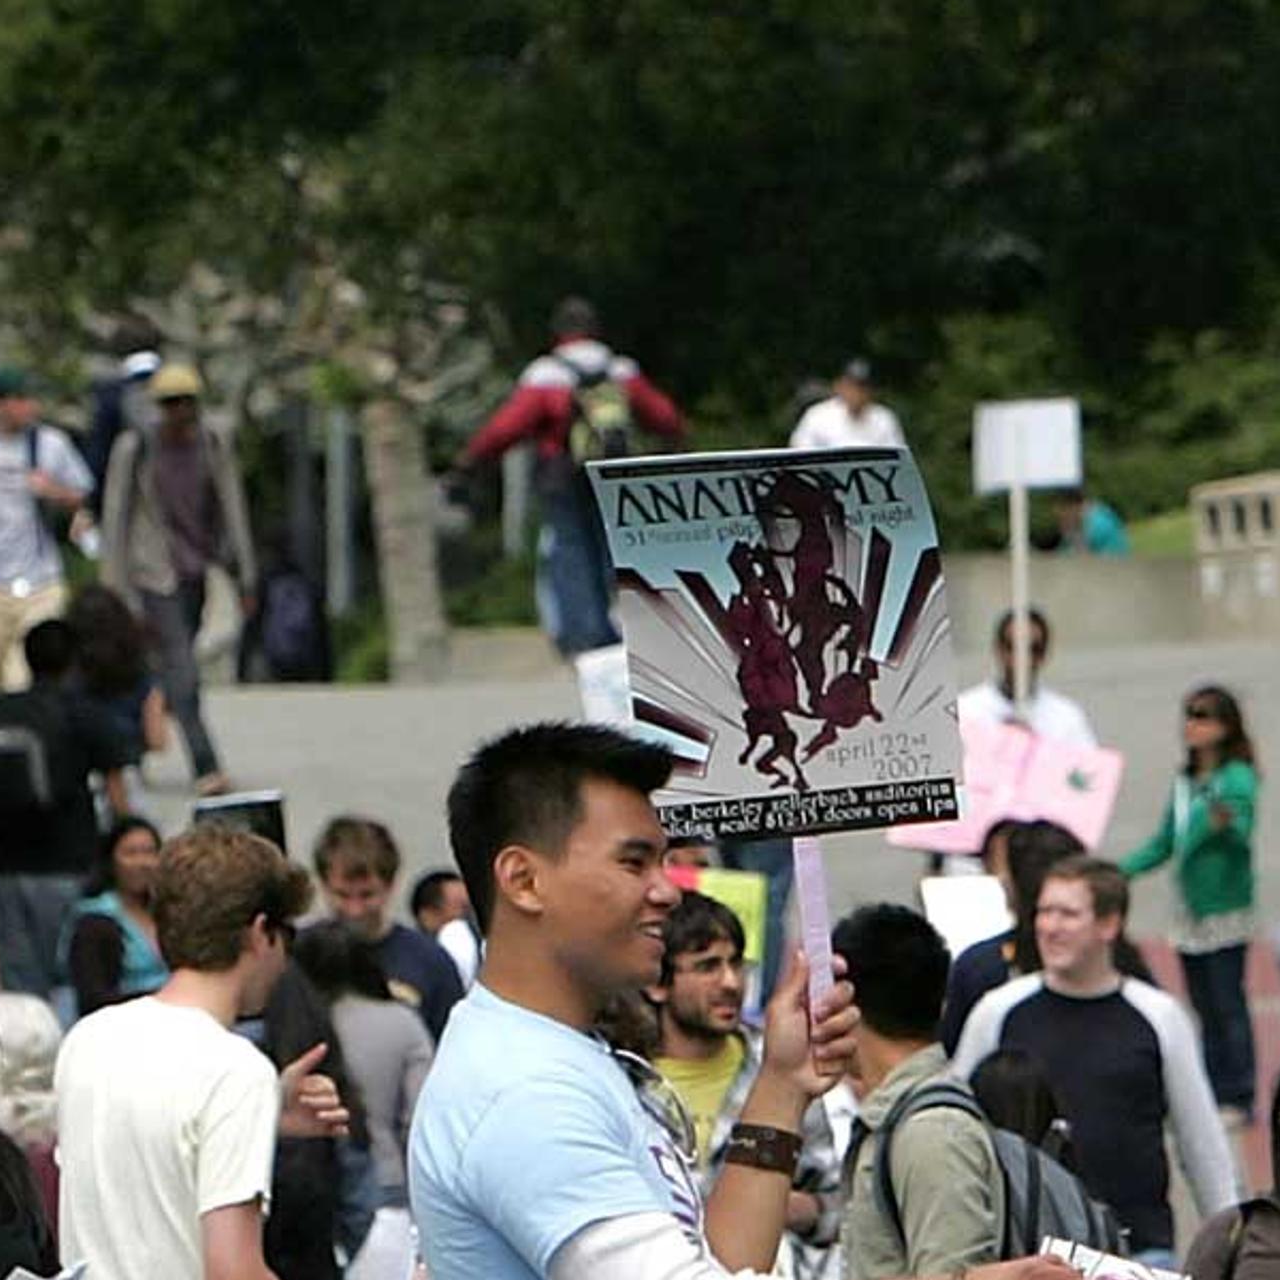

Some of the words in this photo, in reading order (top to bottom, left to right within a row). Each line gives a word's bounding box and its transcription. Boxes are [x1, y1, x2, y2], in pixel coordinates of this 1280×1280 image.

[826, 737, 875, 768] april
[872, 753, 932, 781] 2007
[691, 798, 763, 821] berkeley
[864, 780, 952, 804] auditorium
[719, 813, 760, 834] scale
[823, 801, 872, 823] doors
[877, 797, 919, 822] open
